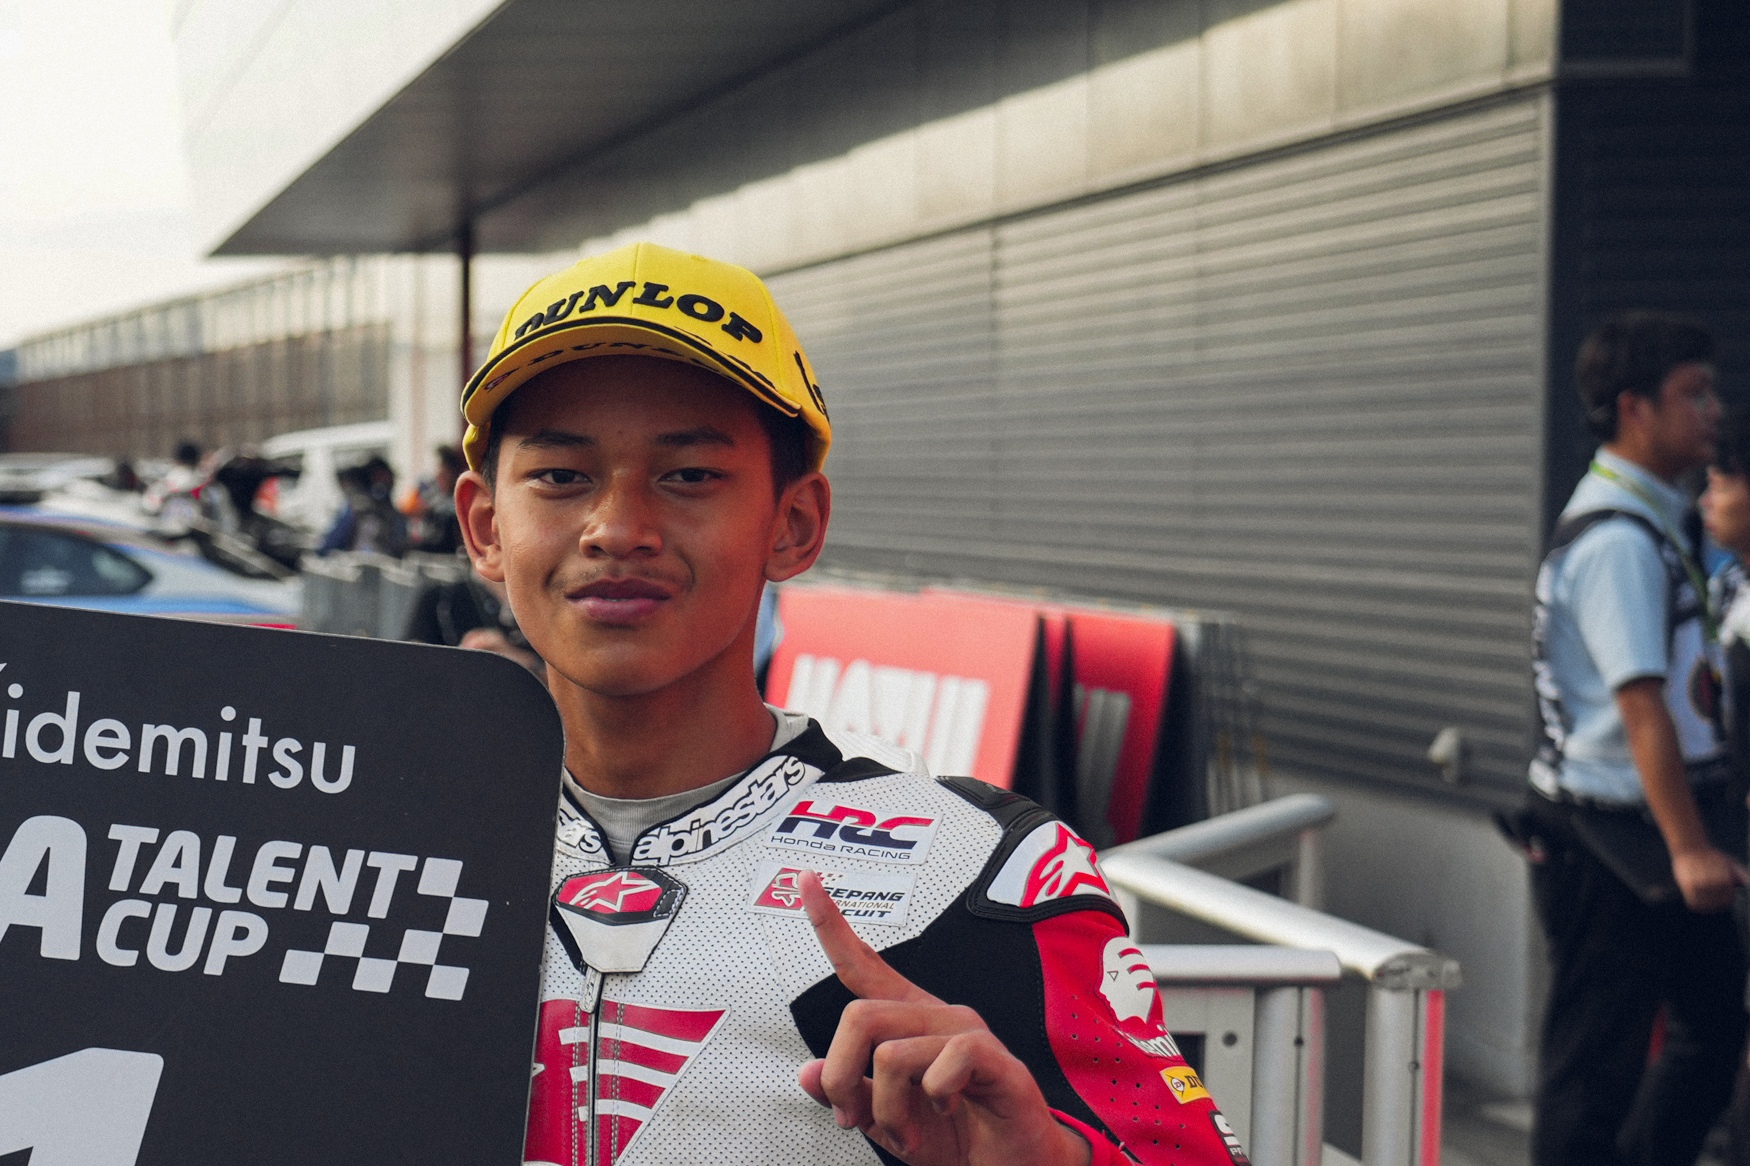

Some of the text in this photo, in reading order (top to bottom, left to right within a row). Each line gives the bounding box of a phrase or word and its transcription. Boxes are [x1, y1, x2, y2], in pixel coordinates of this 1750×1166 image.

[514, 281, 764, 344] DUNLOP
[2, 683, 356, 795] idemitsu
[631, 756, 806, 868] alpinestars
[776, 800, 936, 850] HRC
[107, 823, 418, 920] TALENT
[770, 836, 912, 860] Honda RACING
[823, 886, 905, 902] SEPANG
[832, 898, 895, 911] RNATIONAL
[840, 908, 892, 918] CUIT
[96, 899, 270, 976] CUP
